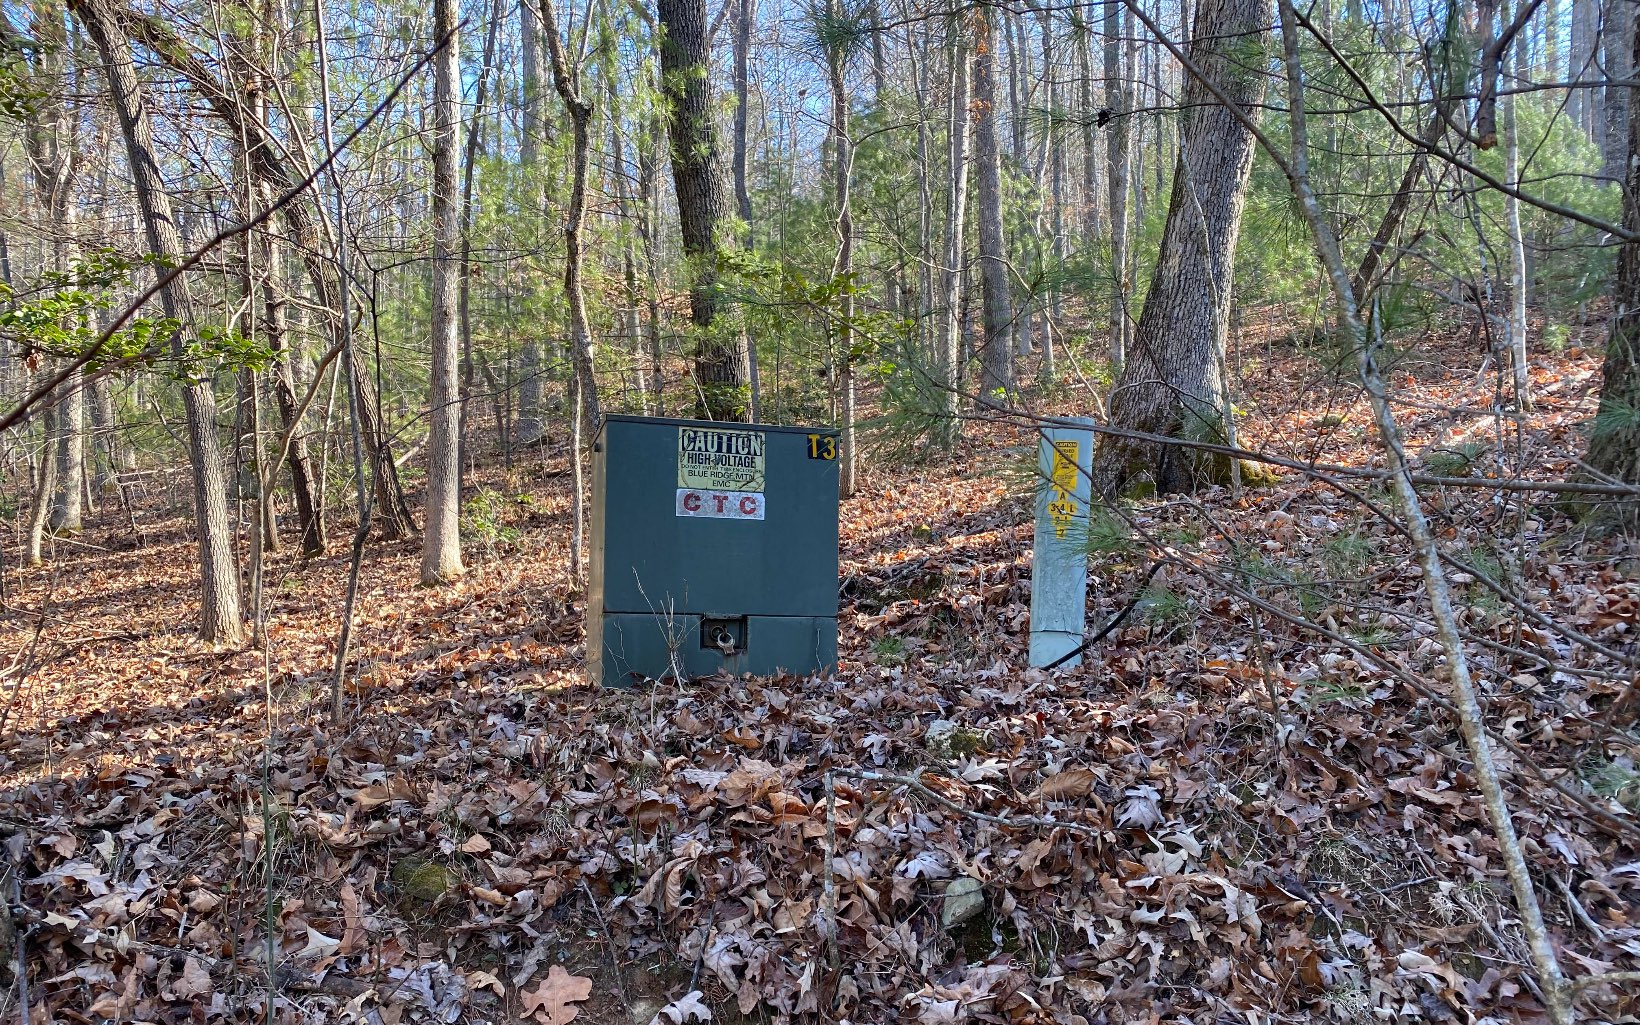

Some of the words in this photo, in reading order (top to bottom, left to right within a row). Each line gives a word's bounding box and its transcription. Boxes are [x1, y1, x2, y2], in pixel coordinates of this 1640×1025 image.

[683, 429, 762, 456] CAUTION
[808, 434, 836, 460] T3
[687, 452, 711, 466] HIGH
[687, 469, 708, 478] BLUE
[710, 471, 733, 479] RIDGE
[735, 473, 754, 481] MTN
[712, 480, 731, 488] EMC
[1060, 491, 1066, 501] A
